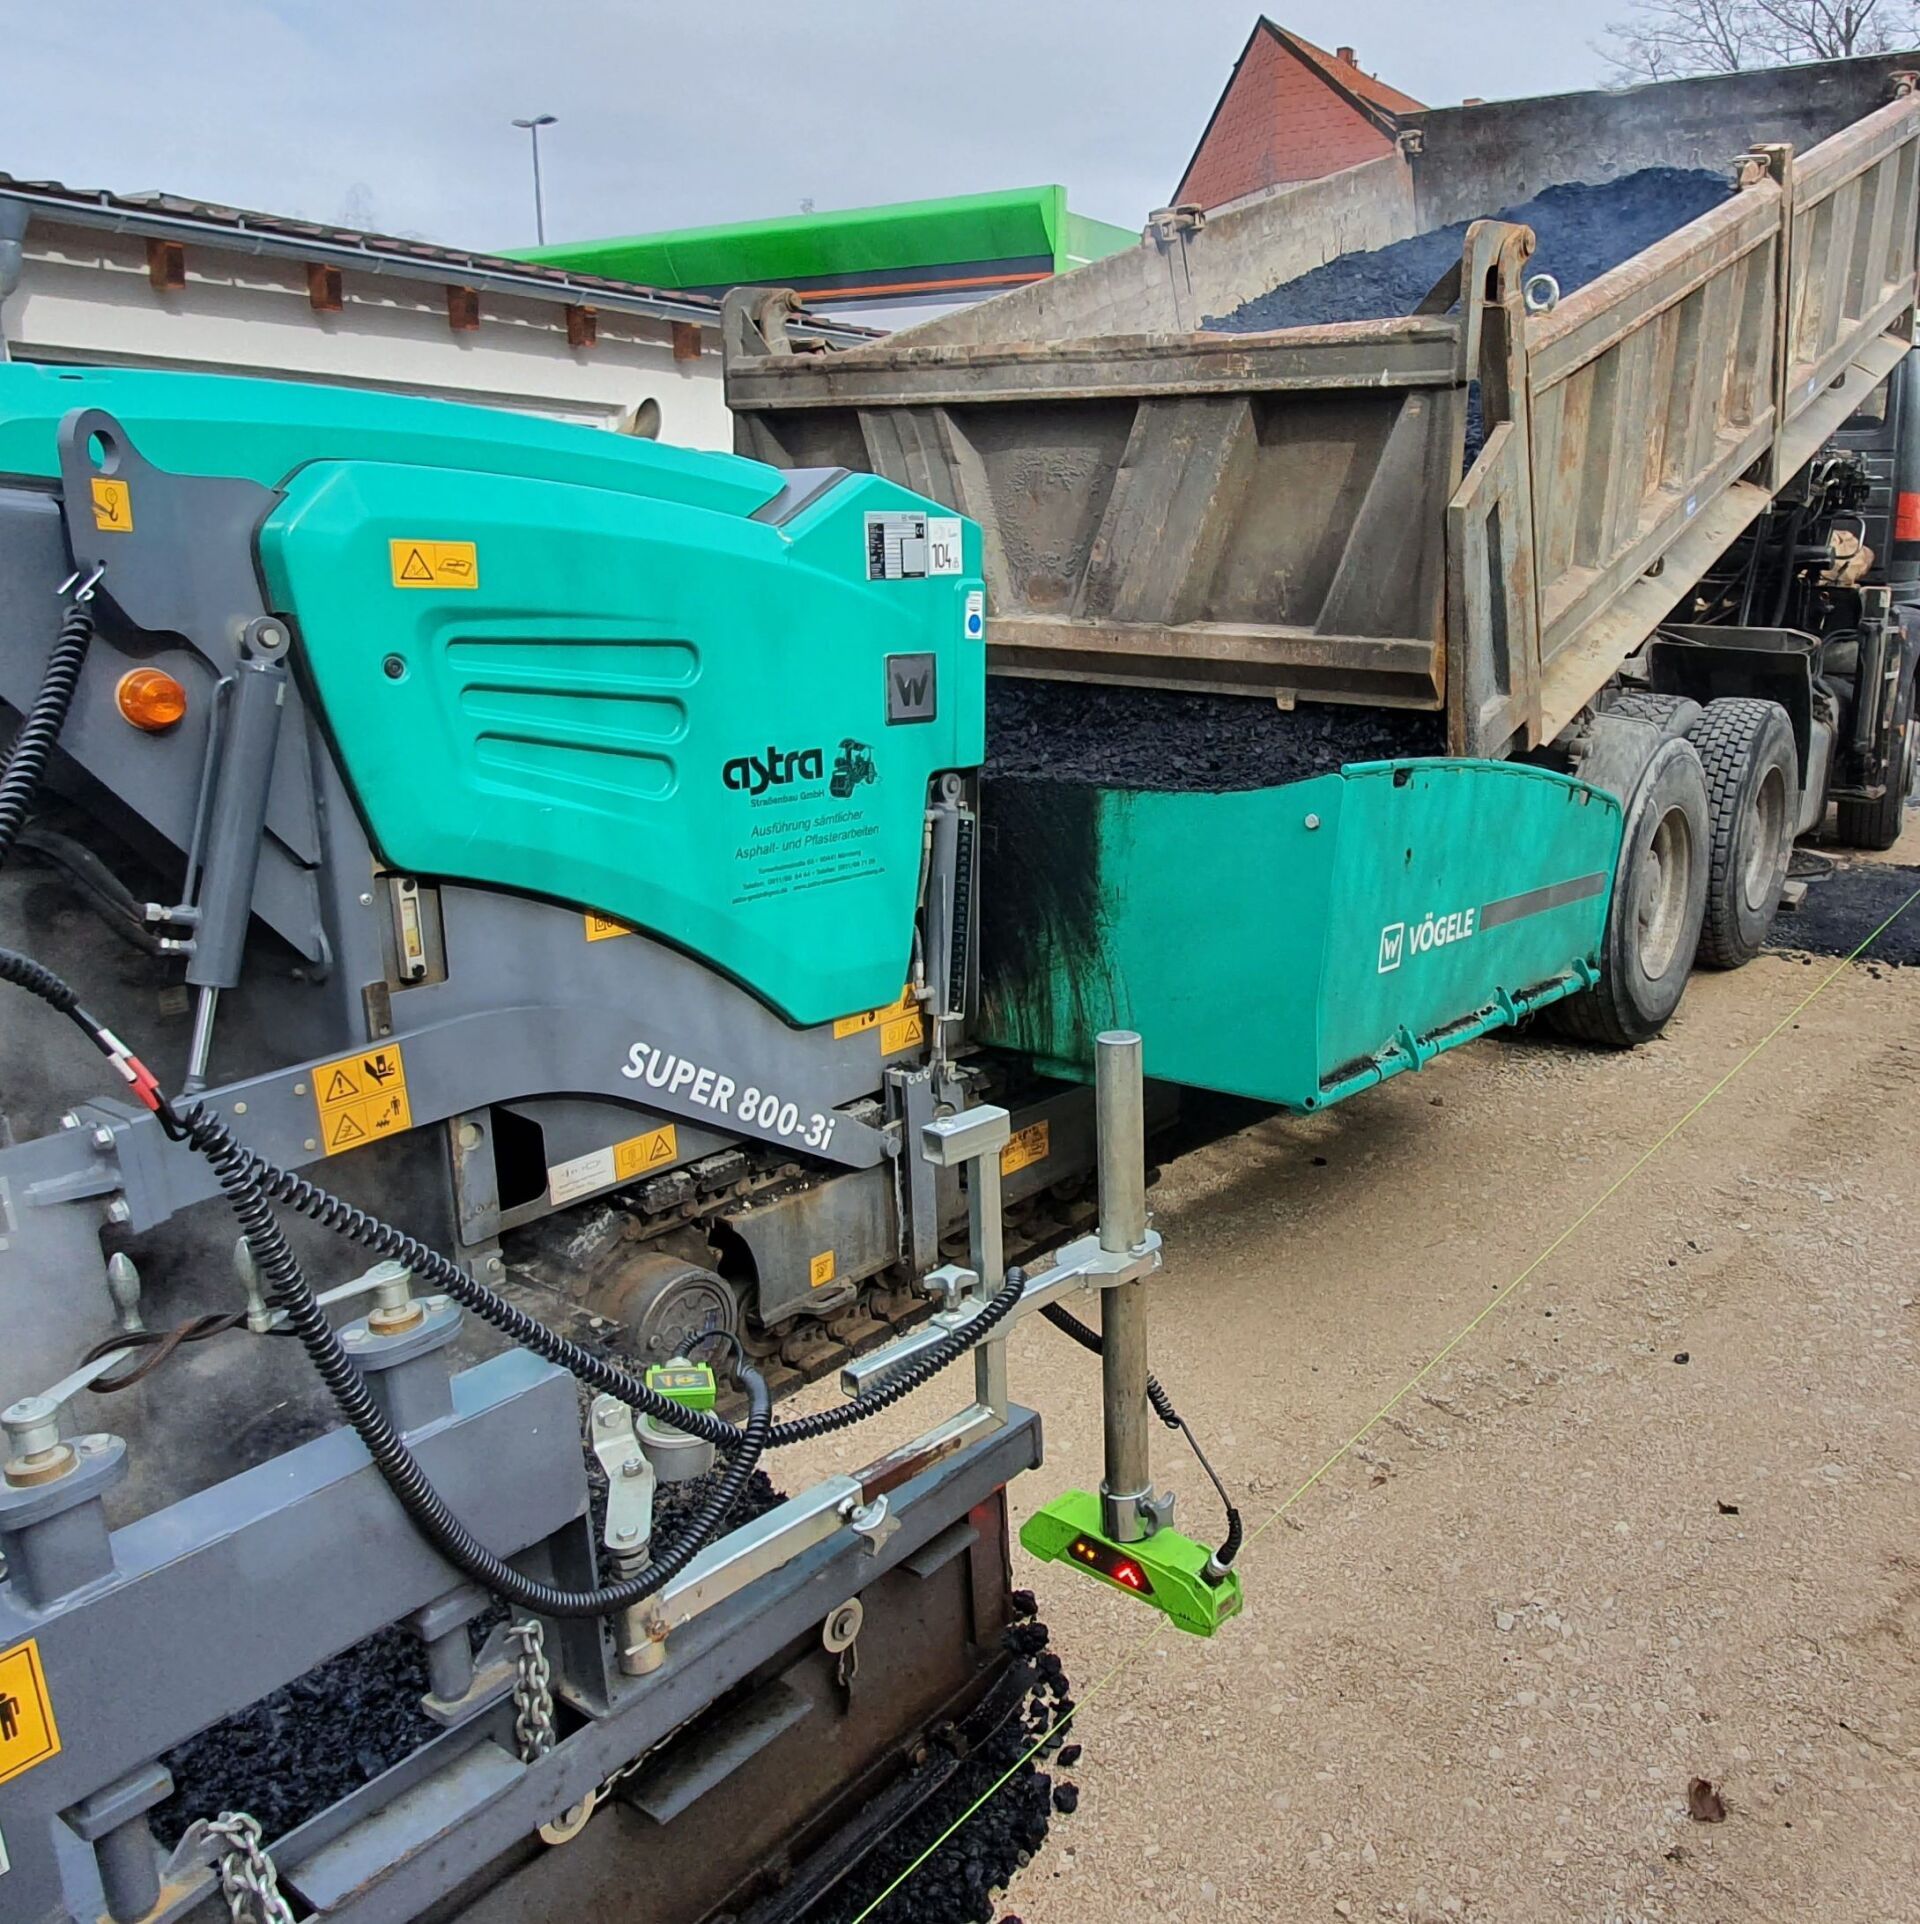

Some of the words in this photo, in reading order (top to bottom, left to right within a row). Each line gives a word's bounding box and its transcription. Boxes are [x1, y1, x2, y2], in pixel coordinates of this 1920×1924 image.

[932, 544, 952, 568] 104
[894, 669, 929, 706] W
[722, 746, 824, 795] astra
[751, 794, 799, 808] Straßenbau
[800, 789, 825, 800] GmbH
[734, 842, 780, 861] Asphalt-
[781, 838, 801, 852] und
[803, 824, 880, 846] Pflasterarbeiten
[750, 818, 812, 838] Ausführung
[813, 811, 864, 828] sämtlicher
[1409, 908, 1476, 955] VÖGELE
[621, 1042, 736, 1114] SUPER
[737, 1087, 836, 1151] 800-3i
